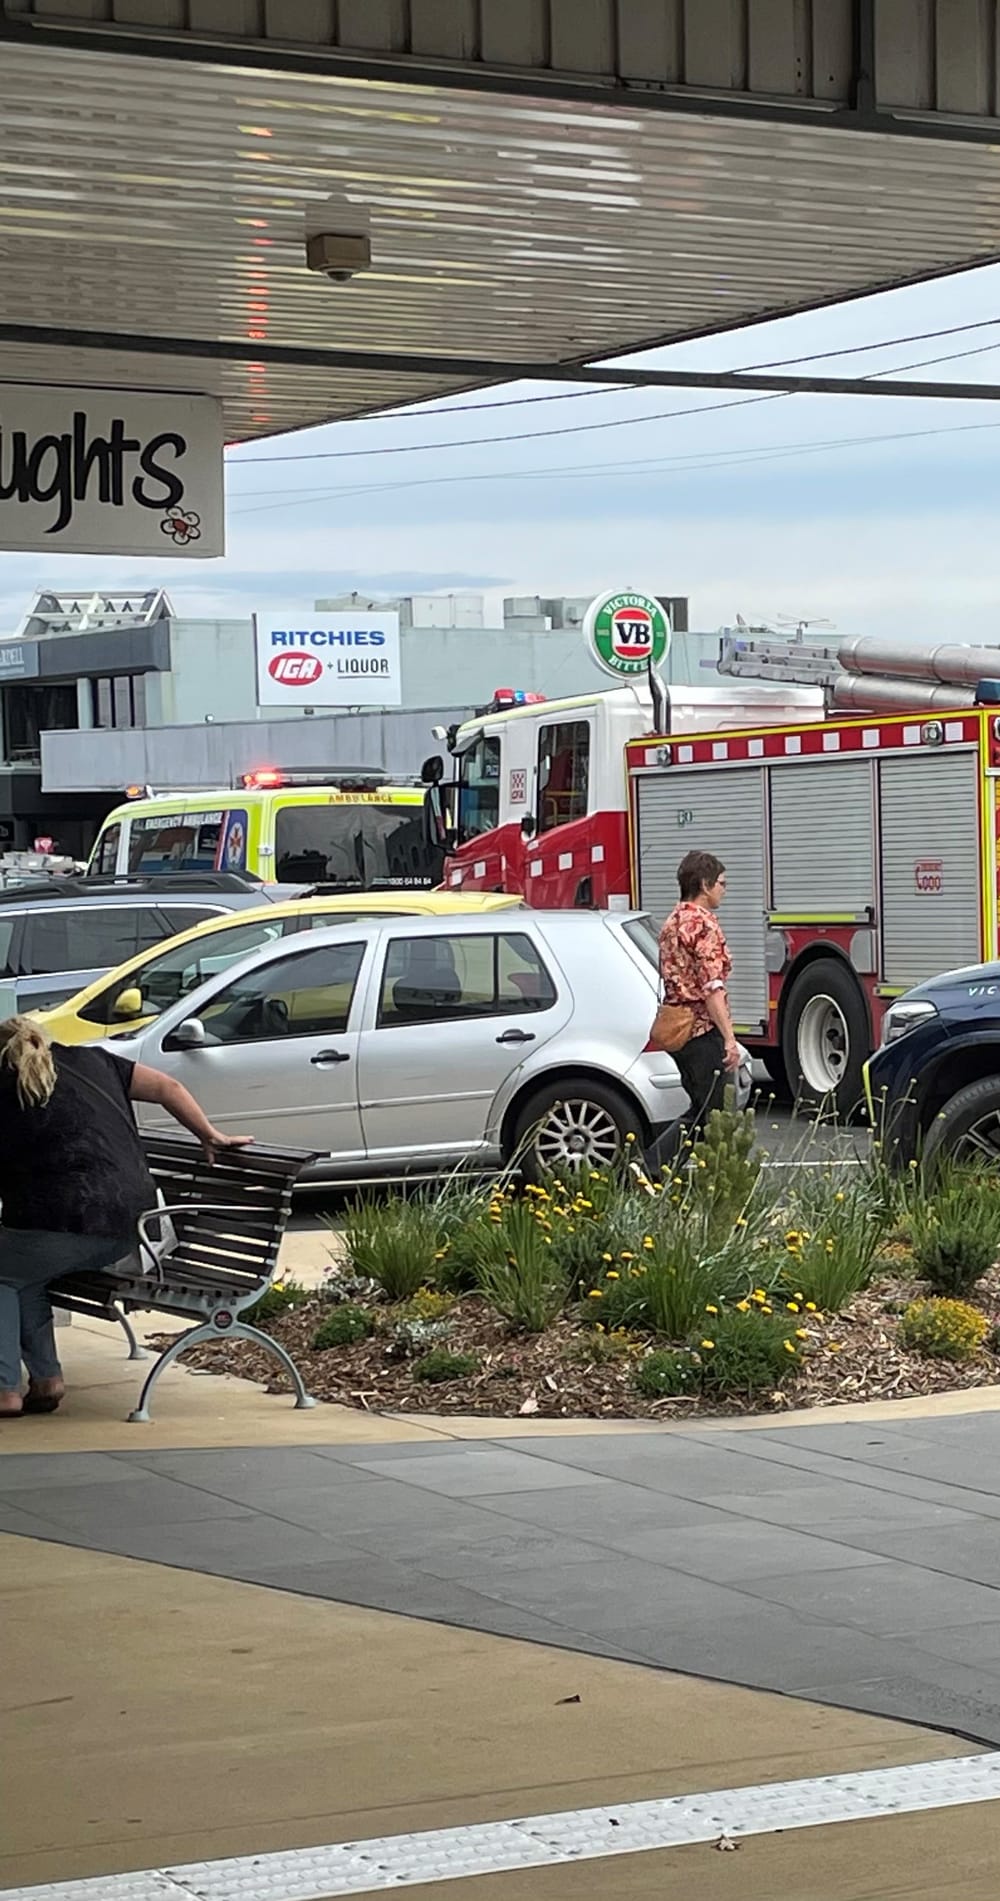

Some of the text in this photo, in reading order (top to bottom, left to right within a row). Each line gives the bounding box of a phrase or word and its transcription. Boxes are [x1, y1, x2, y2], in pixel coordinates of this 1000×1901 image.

[603, 595, 658, 618] VICTORIA
[271, 631, 385, 646] RITCHIES
[615, 622, 650, 644] VB
[274, 658, 318, 679] IGA
[337, 658, 389, 673] LIQUOR
[608, 655, 650, 671] BITTE
[329, 793, 393, 804] AMBULANCE
